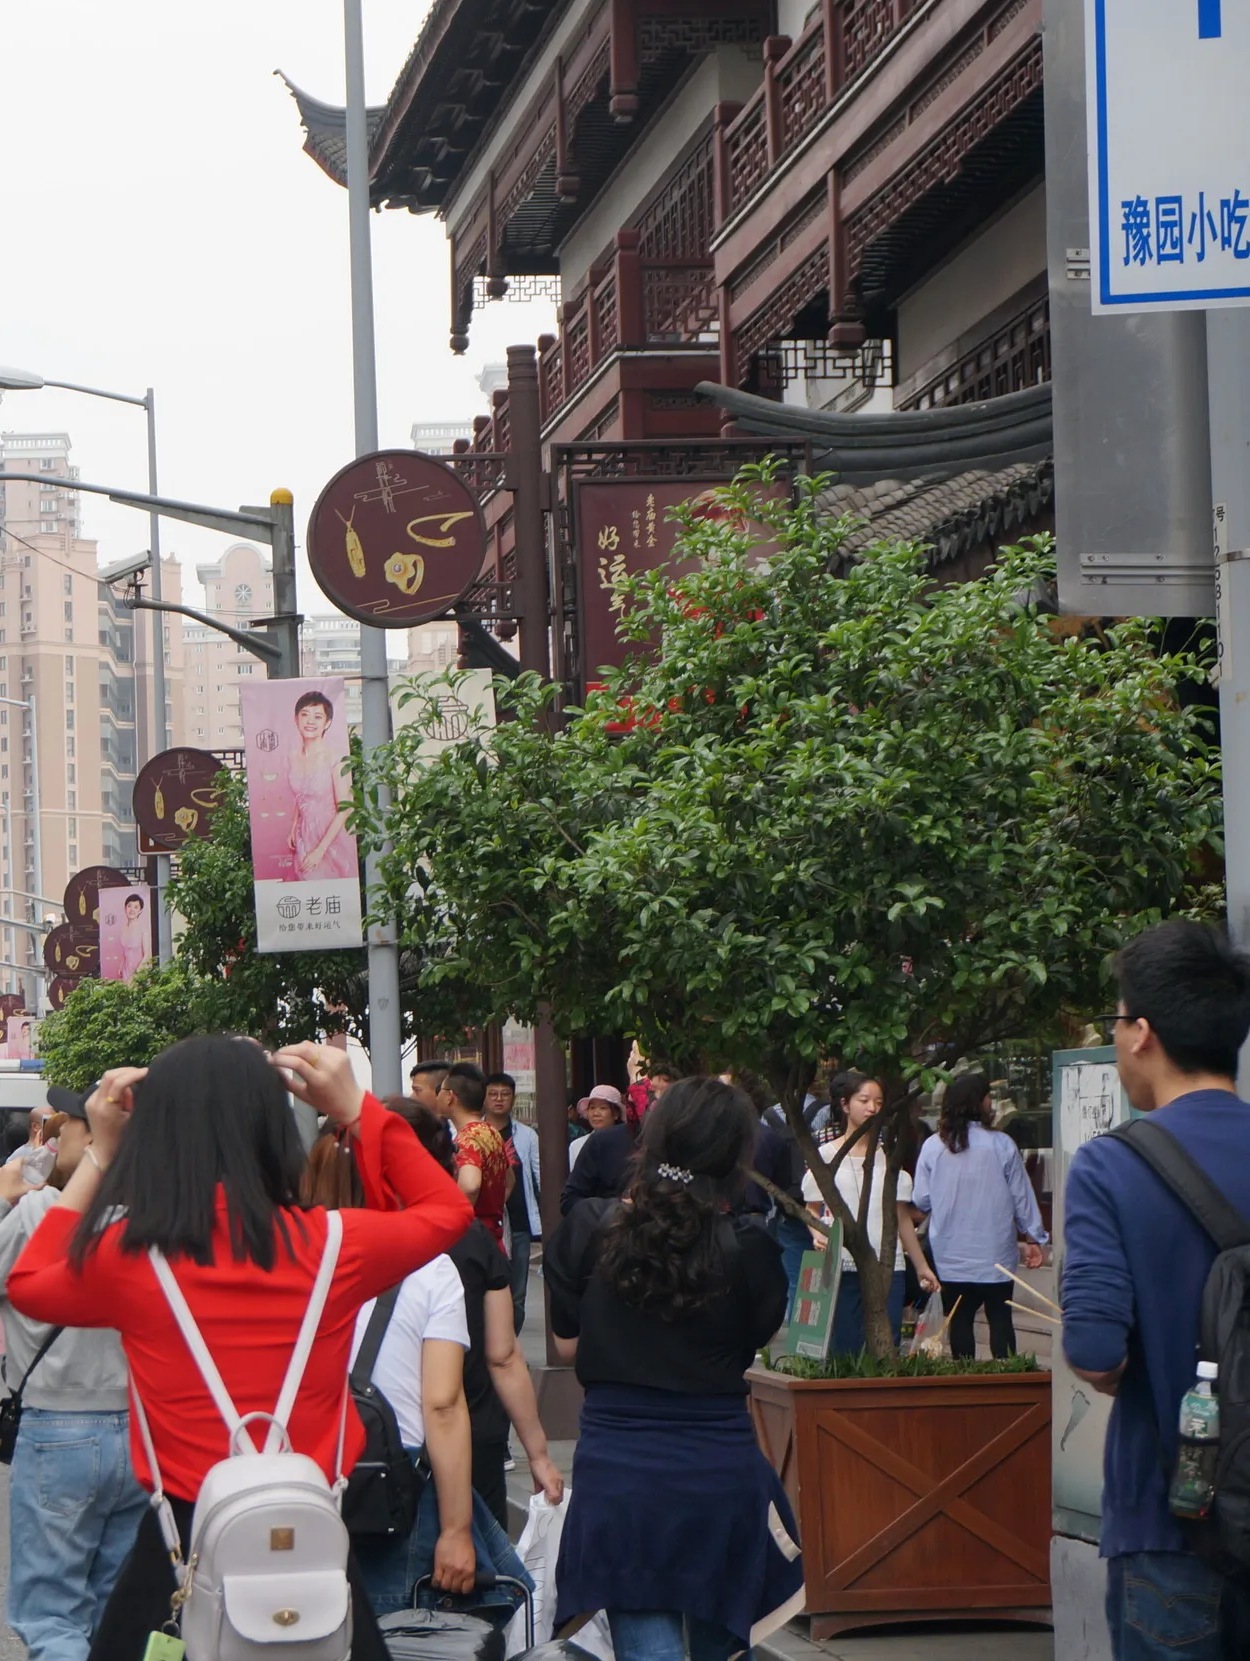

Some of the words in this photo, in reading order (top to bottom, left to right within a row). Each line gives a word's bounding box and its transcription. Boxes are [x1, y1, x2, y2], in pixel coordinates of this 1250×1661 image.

[1121, 188, 1250, 267] 豫园小吃
[305, 895, 341, 915] 老庙
